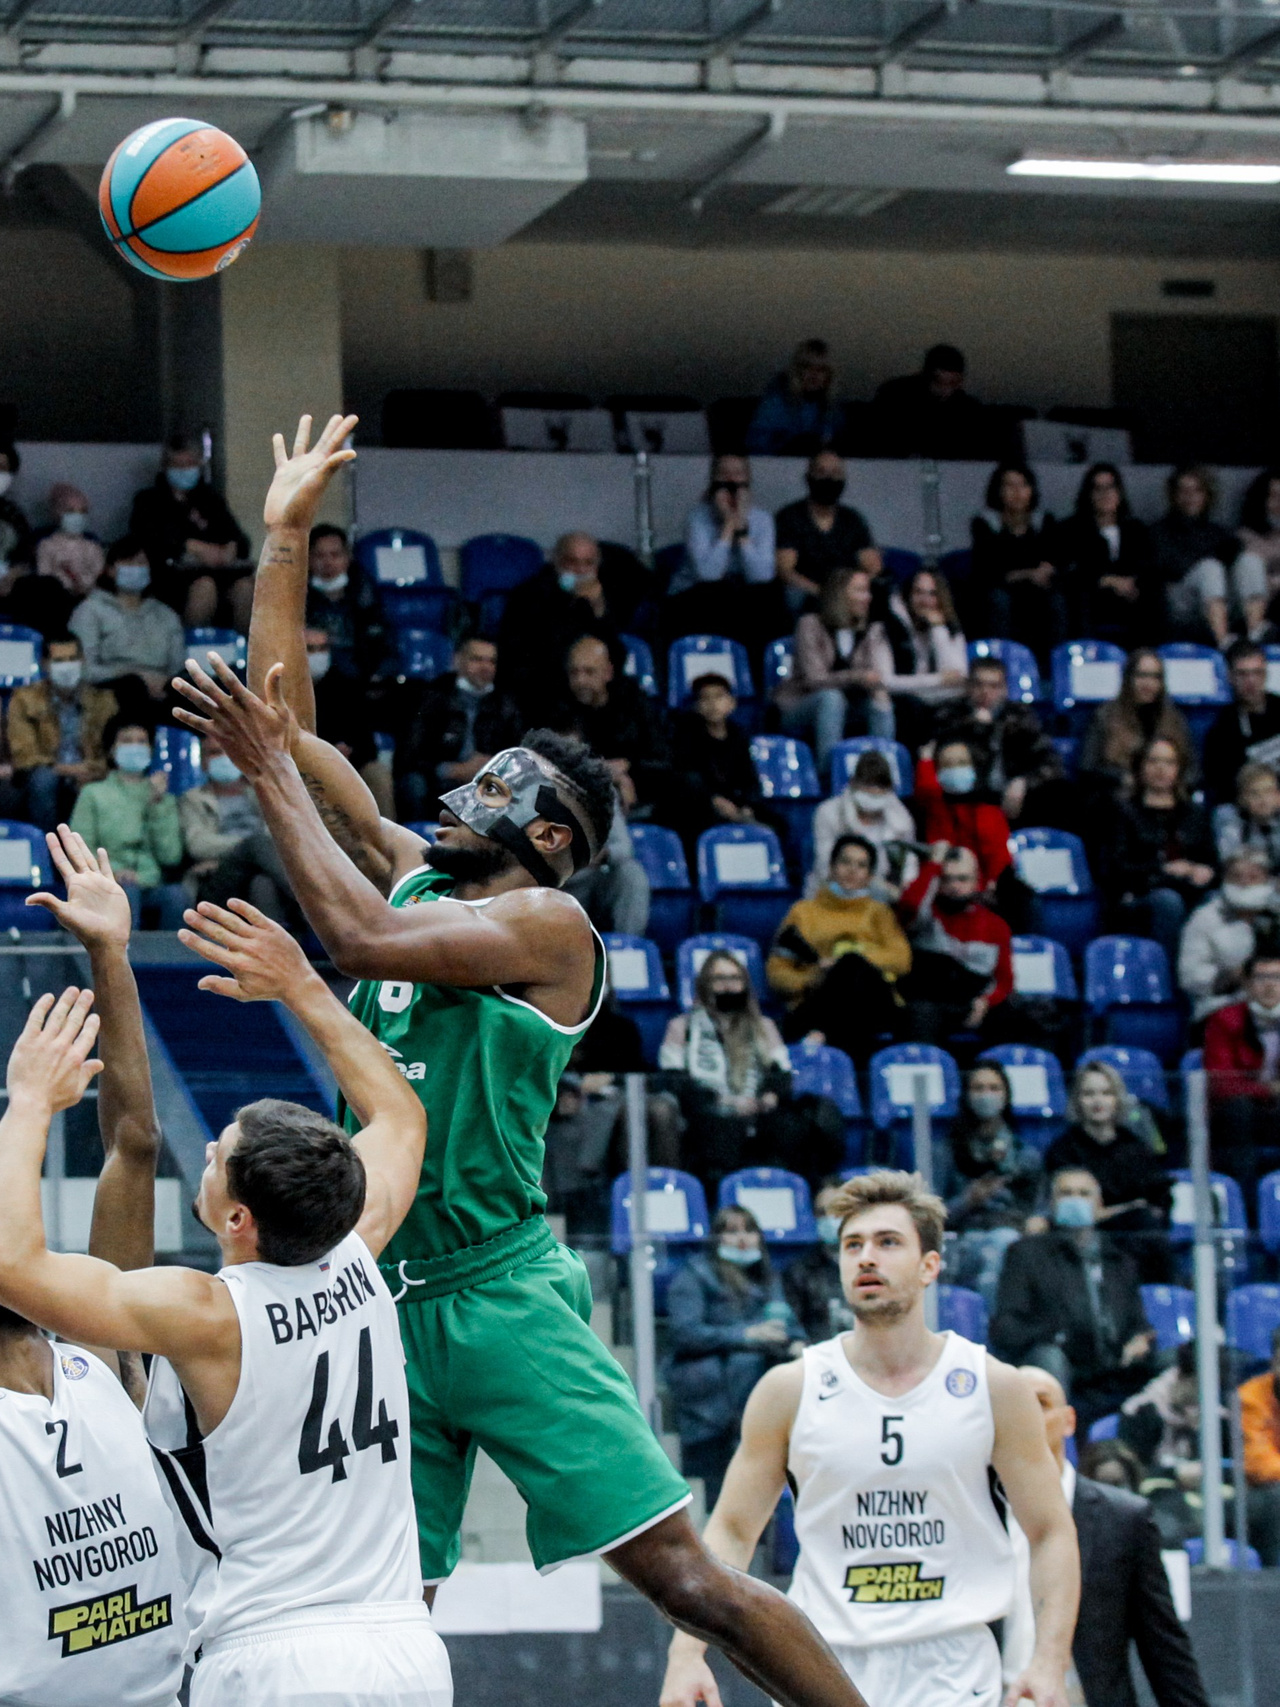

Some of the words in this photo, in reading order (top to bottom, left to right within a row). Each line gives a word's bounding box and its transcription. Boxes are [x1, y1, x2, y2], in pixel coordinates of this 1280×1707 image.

[298, 1326, 399, 1484] 44
[45, 1419, 83, 1478] 2
[881, 1416, 904, 1466] 5
[44, 1493, 127, 1547] NIZHNY
[857, 1490, 927, 1516] NIZHNY
[33, 1526, 159, 1591] NOVGOROD
[842, 1520, 945, 1549] NOVGOROD
[847, 1565, 918, 1587] PARI
[854, 1579, 942, 1601] MATCH
[54, 1591, 131, 1634] PARI
[69, 1601, 169, 1652] MATCH
